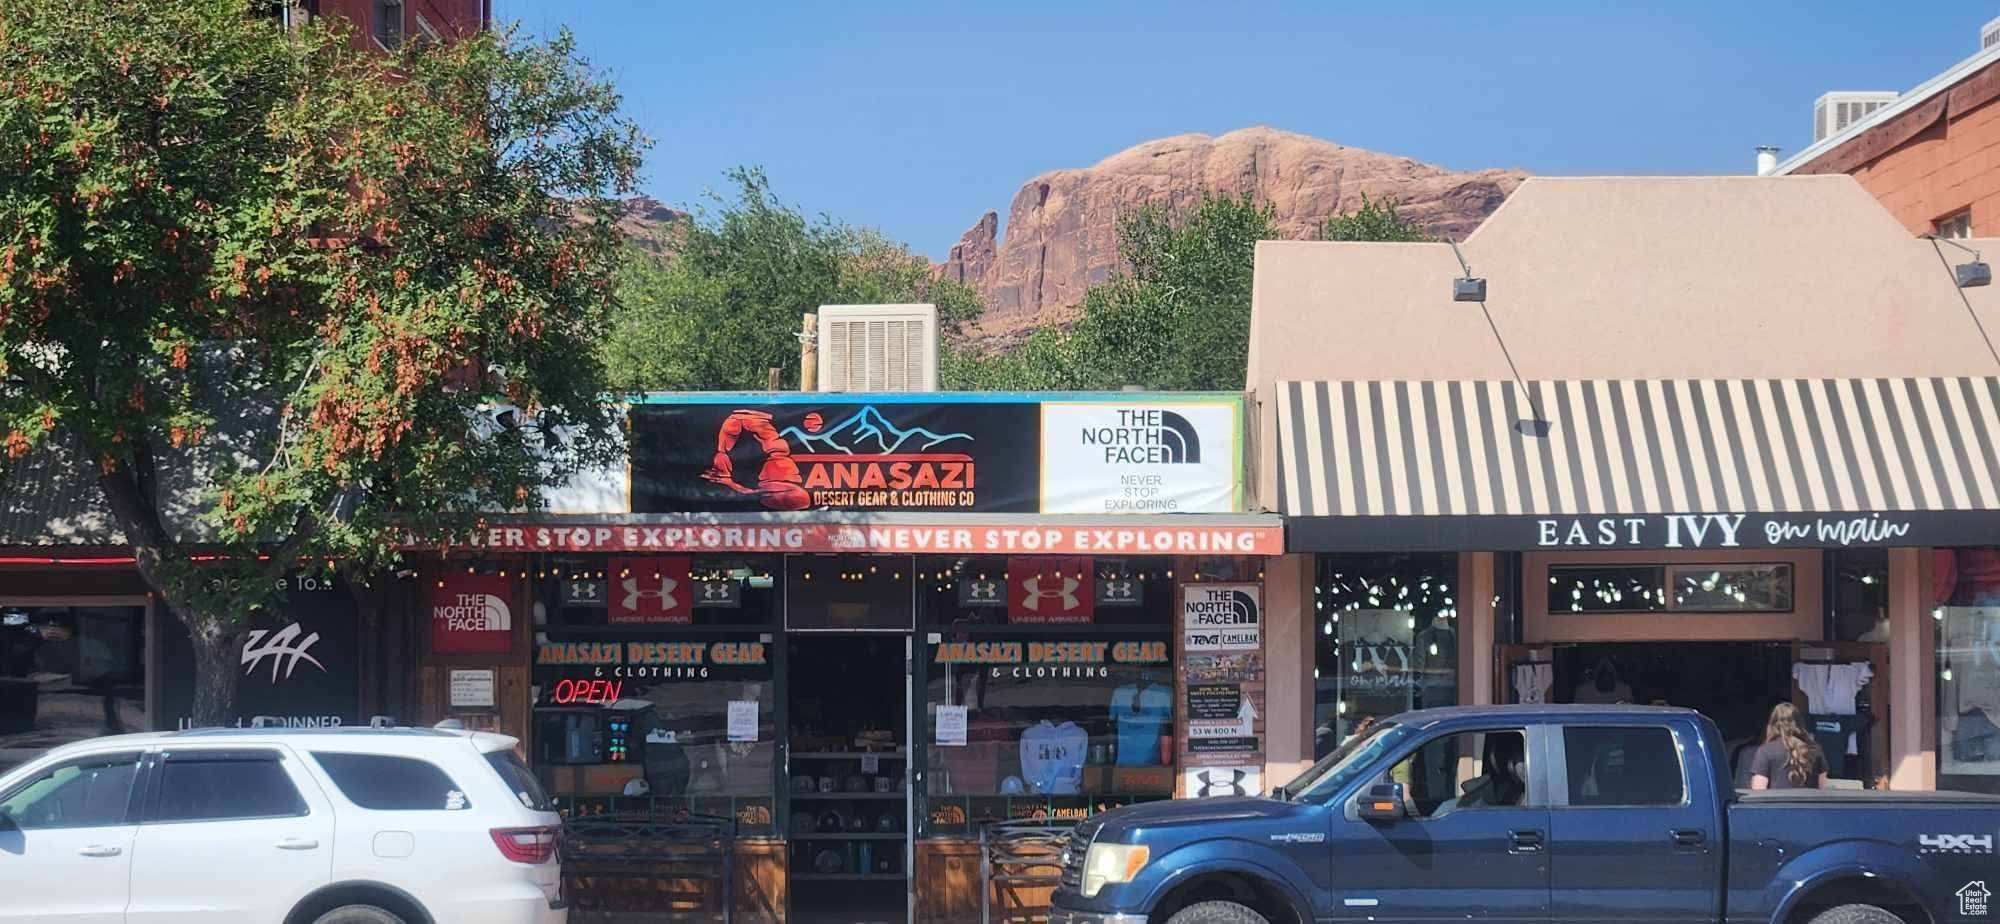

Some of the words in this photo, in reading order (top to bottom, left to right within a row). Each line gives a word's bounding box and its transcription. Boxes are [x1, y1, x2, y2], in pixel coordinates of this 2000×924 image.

[1117, 409, 1160, 426] THE
[1082, 427, 1160, 445] NORTH
[1105, 446, 1160, 464] FACE
[804, 462, 974, 489] ANASAZI
[1120, 474, 1162, 486] NEVER
[814, 491, 855, 506] DESERT
[858, 491, 888, 506] GEAR
[890, 491, 899, 506] &
[902, 491, 956, 506] CLOTHING
[959, 491, 974, 506] CO
[1123, 487, 1160, 498] STOP
[1105, 499, 1178, 510] EXPLORING
[1537, 518, 1646, 546] EAST
[1663, 514, 1747, 548] IVY
[1764, 520, 1811, 545] on
[1816, 512, 1911, 545] main
[537, 527, 612, 547] STOP
[624, 527, 805, 548] EXPLORING
[869, 529, 973, 550] NEVER
[985, 530, 1062, 551] STOP
[1075, 531, 1256, 551] EXPLORING
[456, 594, 486, 606] THE
[1206, 590, 1232, 602] THE
[434, 607, 486, 619] NORTH
[1186, 602, 1232, 613] NORTH
[448, 619, 486, 631] FACE
[1198, 613, 1232, 625] FACE
[1222, 634, 1258, 644] CAMELBAK
[536, 642, 622, 664] ANASAZI
[628, 642, 706, 664] DESERT
[710, 642, 767, 664] GEAR
[935, 642, 1023, 663] ANASAZI
[1028, 642, 1108, 663] DESERT
[1112, 642, 1169, 662] GEAR
[1353, 646, 1415, 674] IVY
[594, 667, 603, 677] &
[614, 666, 709, 678] CLOTHING
[992, 667, 1001, 678] &
[1012, 667, 1109, 678] CLOTHING
[555, 679, 623, 704] OPEN
[1231, 727, 1238, 735] N
[1052, 807, 1088, 818] CAMELBAK
[1919, 834, 1993, 849] 4X4
